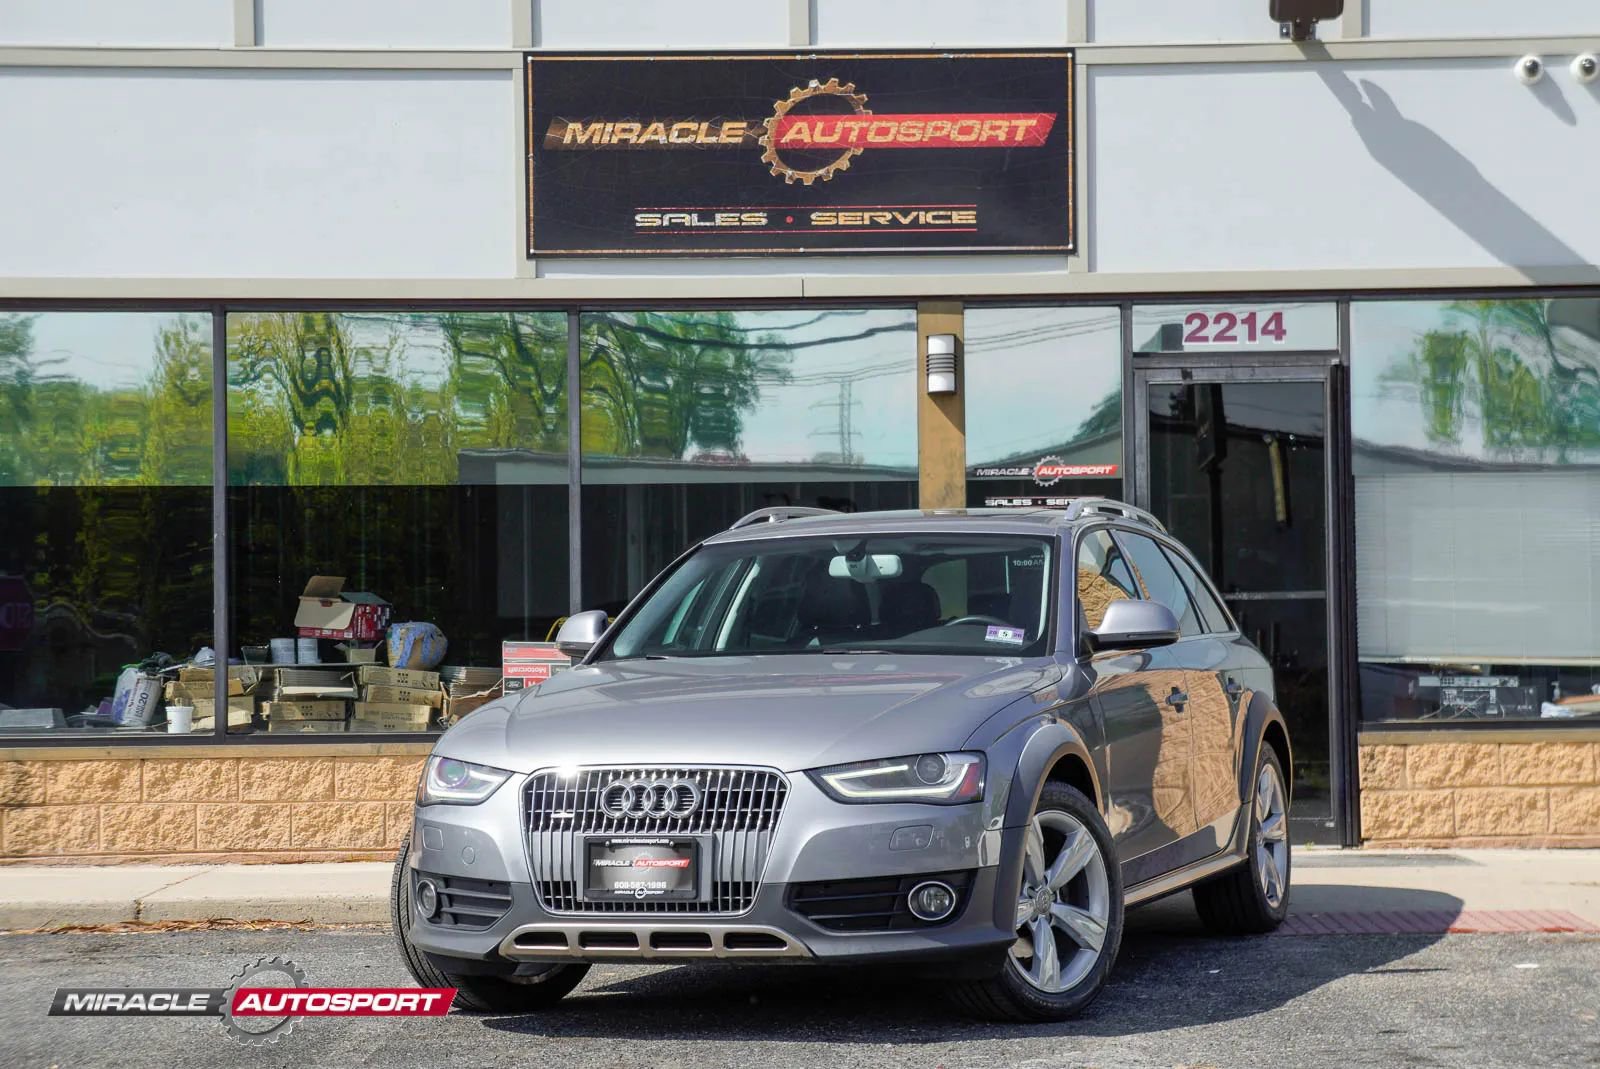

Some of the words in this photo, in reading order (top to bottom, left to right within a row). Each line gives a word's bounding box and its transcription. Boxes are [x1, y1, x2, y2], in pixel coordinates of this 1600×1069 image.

[562, 121, 748, 145] MIRACLE
[780, 119, 1038, 144] AUTOSPORT
[634, 211, 769, 227] SALES
[810, 209, 978, 226] SERVICE
[1183, 311, 1287, 343] 2214
[976, 467, 1030, 476] MIRACLE
[1038, 465, 1113, 475] AUTOSPORT
[984, 498, 1033, 506] SALES
